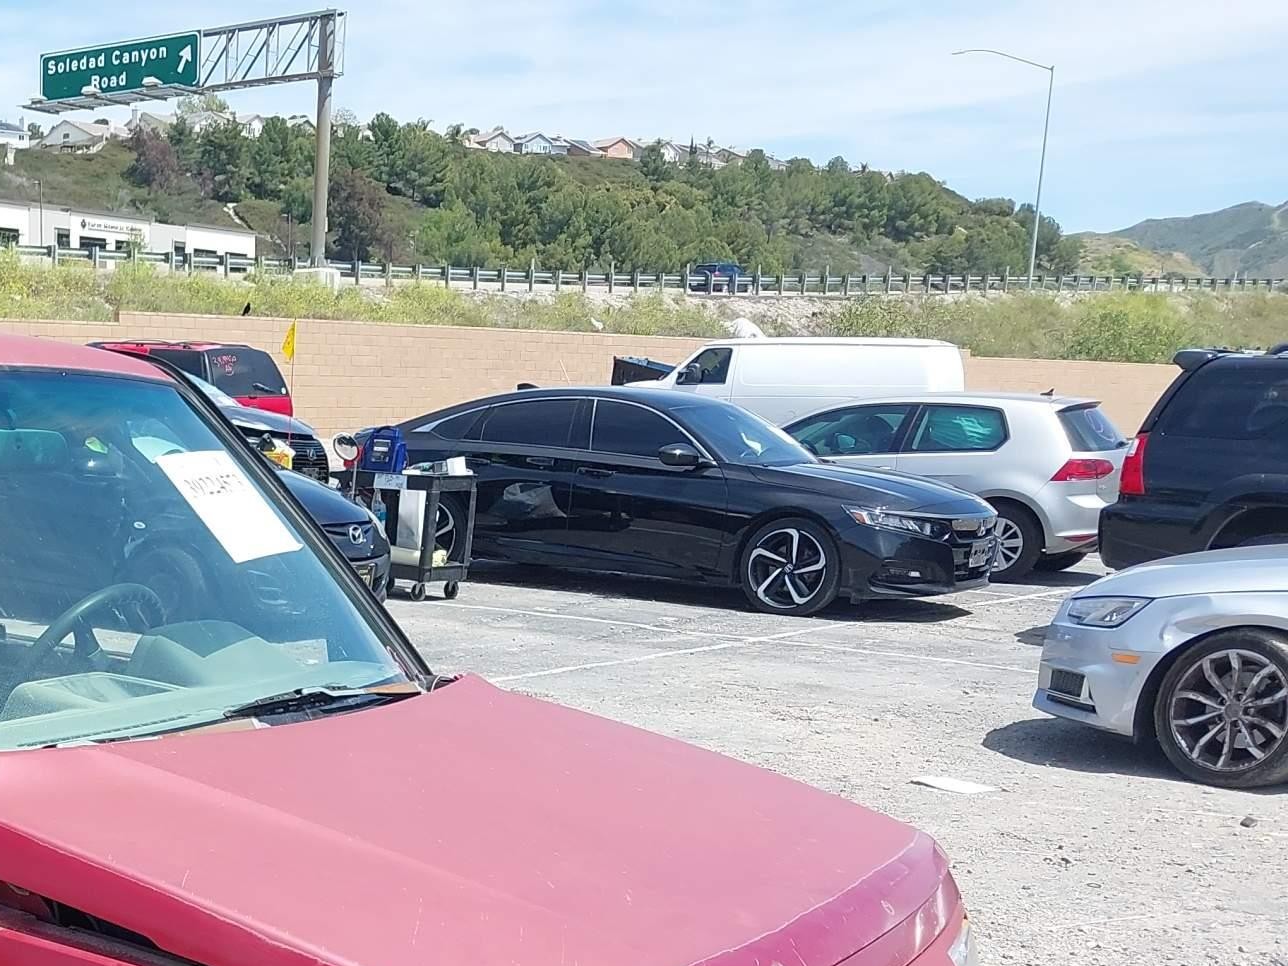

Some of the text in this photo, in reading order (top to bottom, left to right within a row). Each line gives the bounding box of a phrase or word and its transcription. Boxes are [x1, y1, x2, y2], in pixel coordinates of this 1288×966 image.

[47, 46, 167, 75] Soledad Canyon
[91, 71, 127, 90] Road
